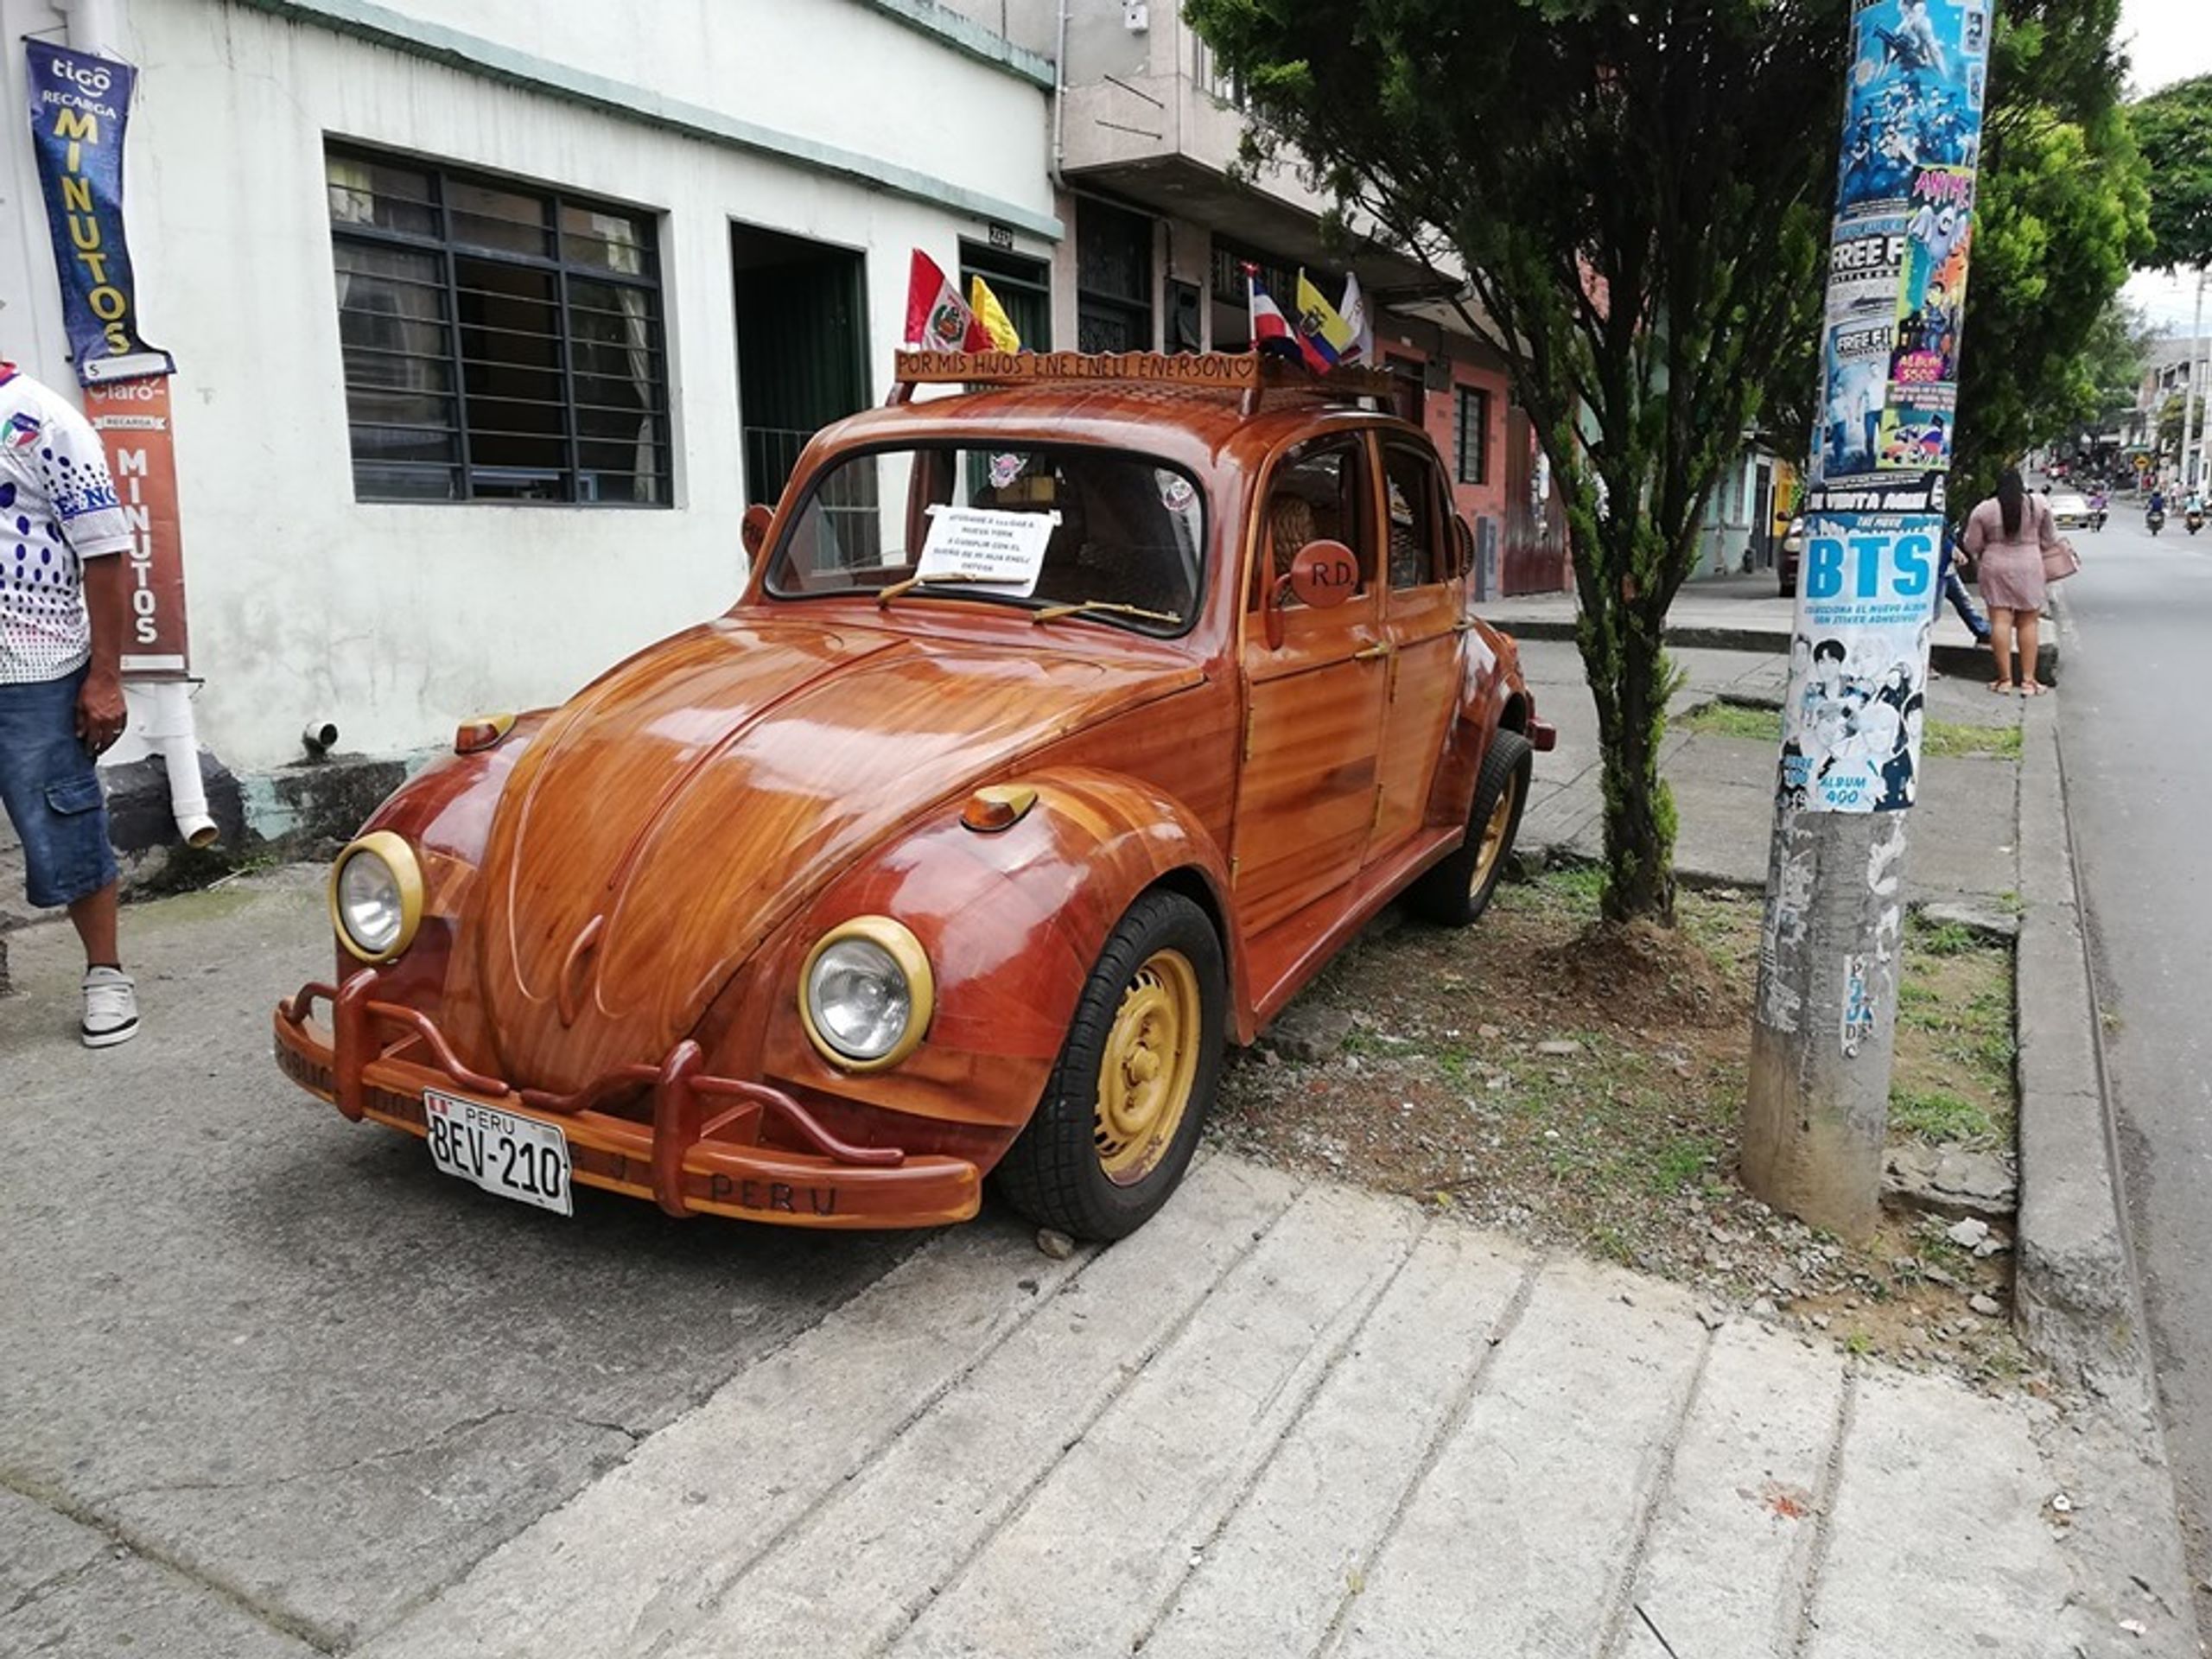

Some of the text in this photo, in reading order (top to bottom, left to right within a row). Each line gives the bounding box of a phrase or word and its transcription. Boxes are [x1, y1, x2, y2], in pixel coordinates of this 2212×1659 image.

[41, 90, 117, 118] RECARGA
[54, 108, 130, 355] MINUTOS
[1832, 237, 1884, 271] FREE
[1838, 331, 1870, 350] FREE
[897, 353, 932, 374] POR
[937, 353, 967, 374] MIS
[973, 353, 1022, 374] HIJOS
[118, 449, 157, 644] MINUTOS
[1807, 535, 1932, 598] BTS
[1819, 777, 1866, 789] ALBUM
[465, 1108, 516, 1135] PERU
[432, 1115, 562, 1199] BEV-210
[710, 1173, 836, 1217] PERU
